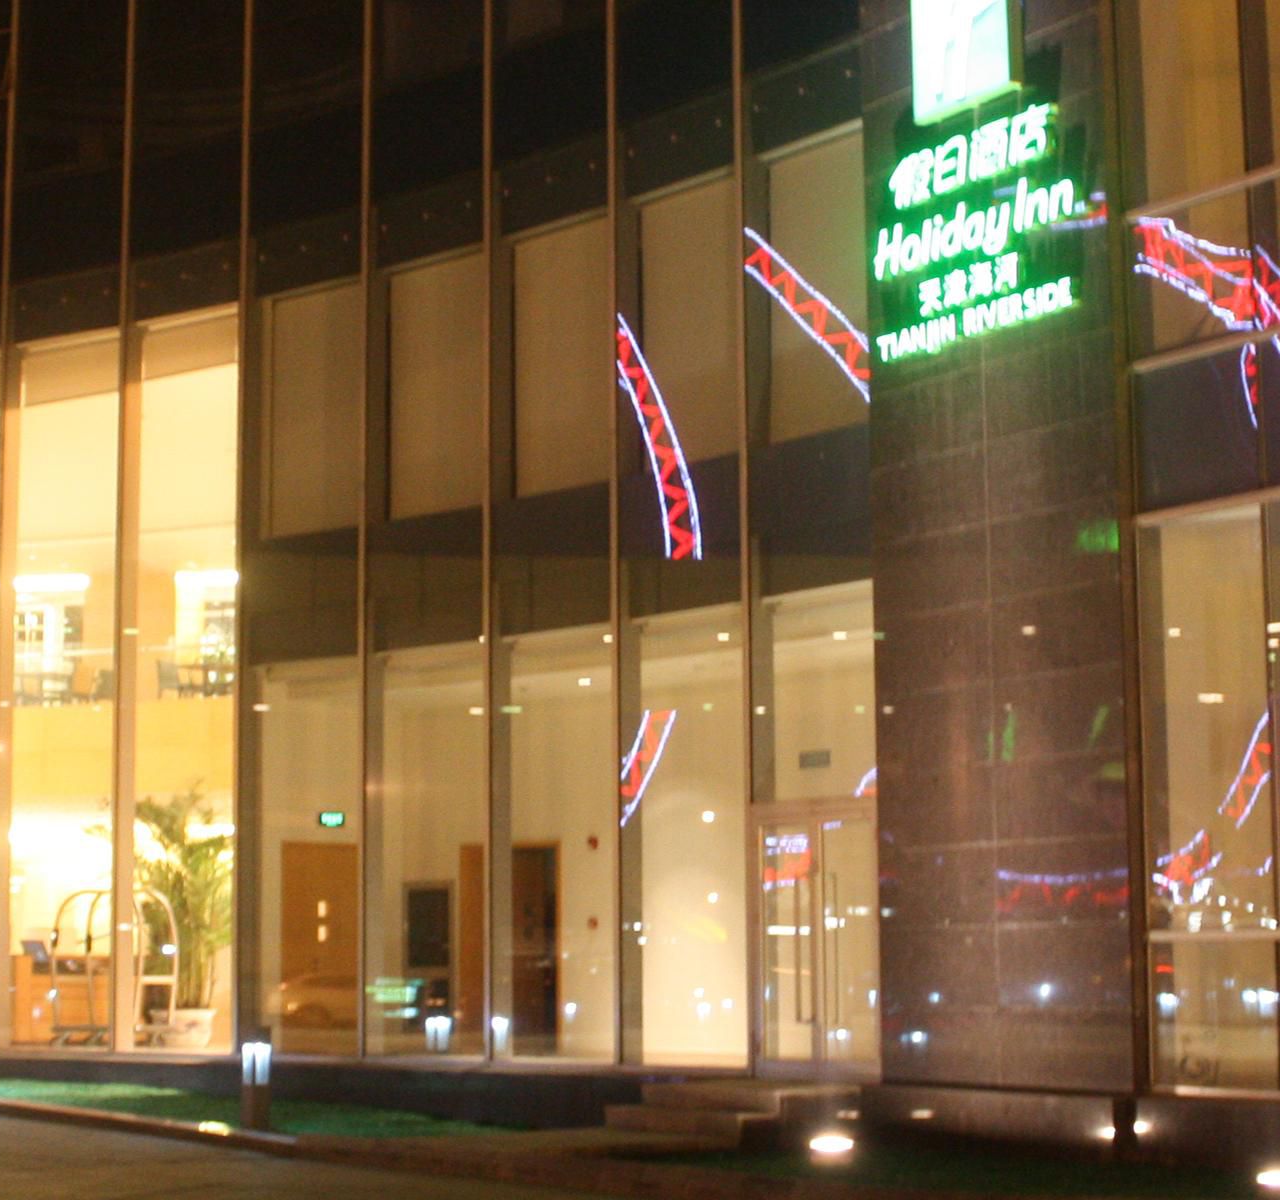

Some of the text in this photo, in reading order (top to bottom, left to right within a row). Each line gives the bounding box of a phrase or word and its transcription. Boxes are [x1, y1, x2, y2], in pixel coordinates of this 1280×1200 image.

[888, 103, 1050, 210] 假日酒店
[874, 176, 1074, 280] Holiday Inn
[876, 276, 1073, 362] TIANJIN RIVERSIDE
